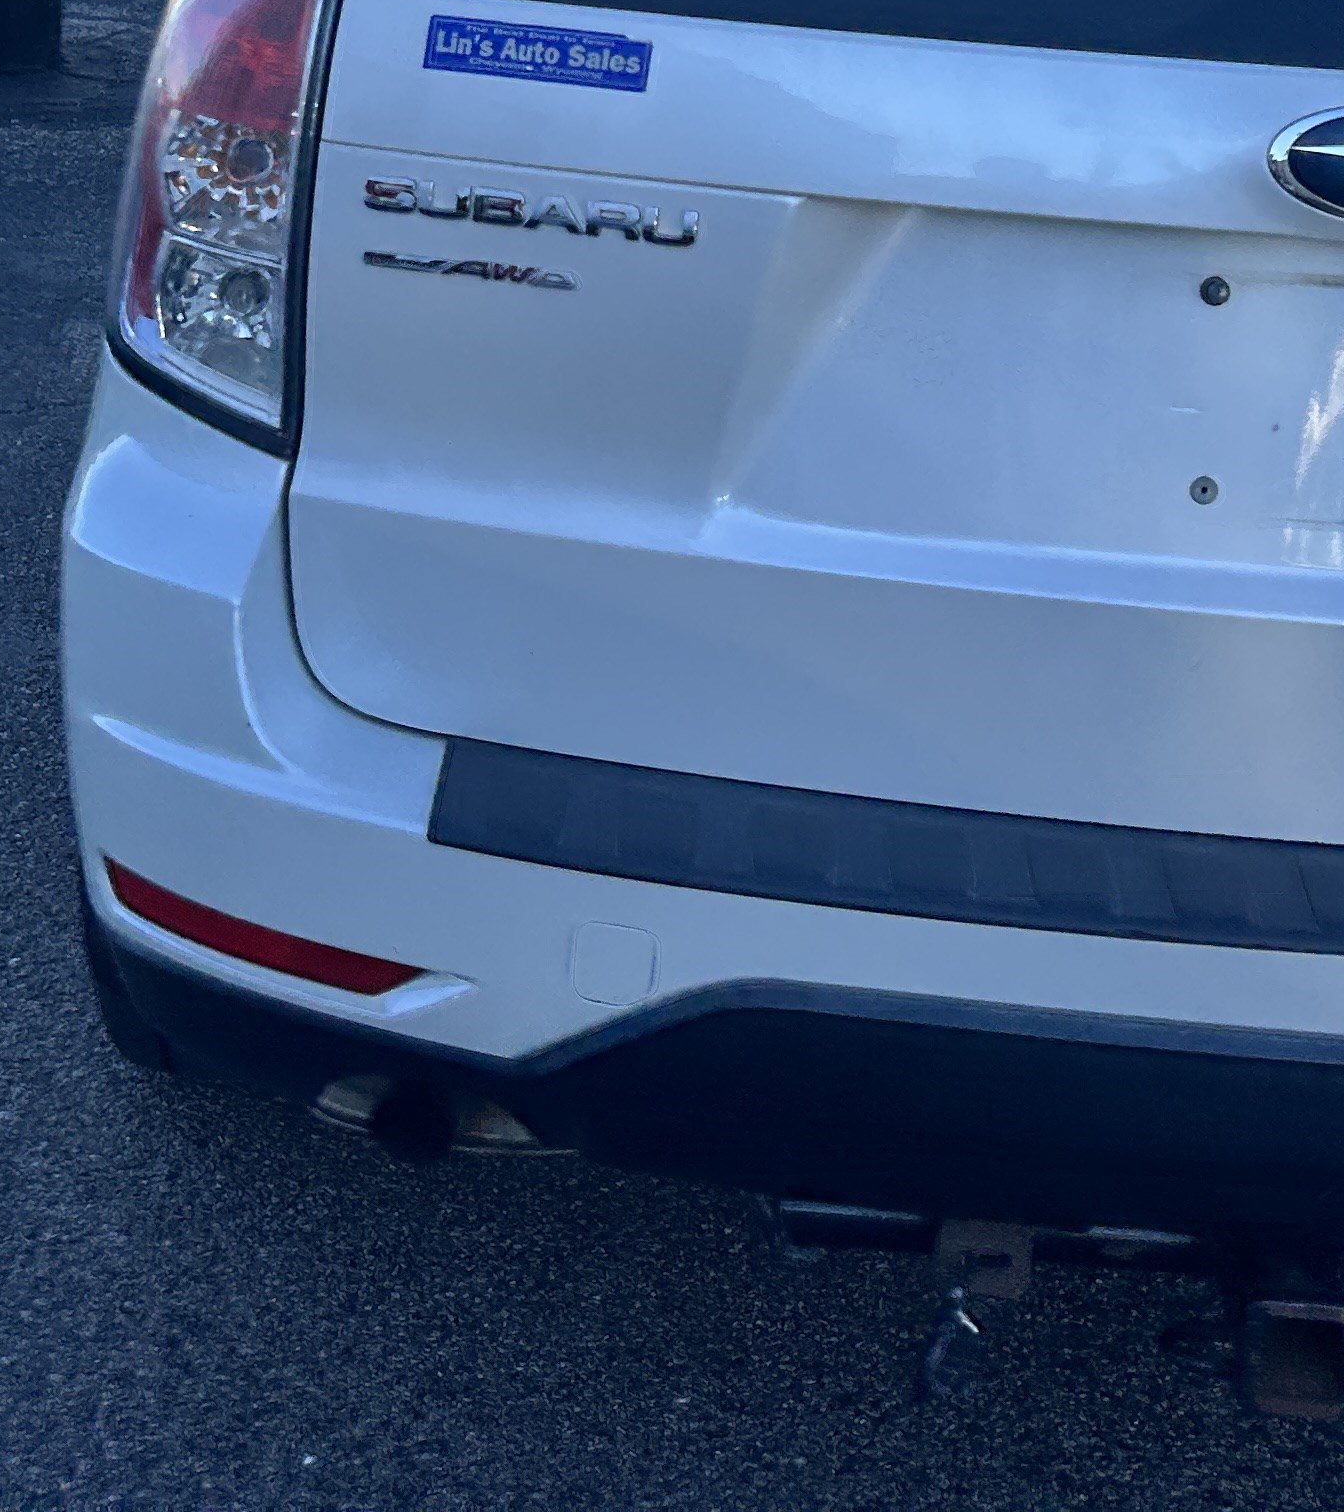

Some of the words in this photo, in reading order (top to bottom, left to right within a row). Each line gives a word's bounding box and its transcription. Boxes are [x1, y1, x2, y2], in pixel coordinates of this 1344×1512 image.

[436, 29, 494, 57] Lin's
[500, 37, 560, 65] Auto
[568, 44, 641, 74] Sales
[364, 175, 699, 246] SUBARU
